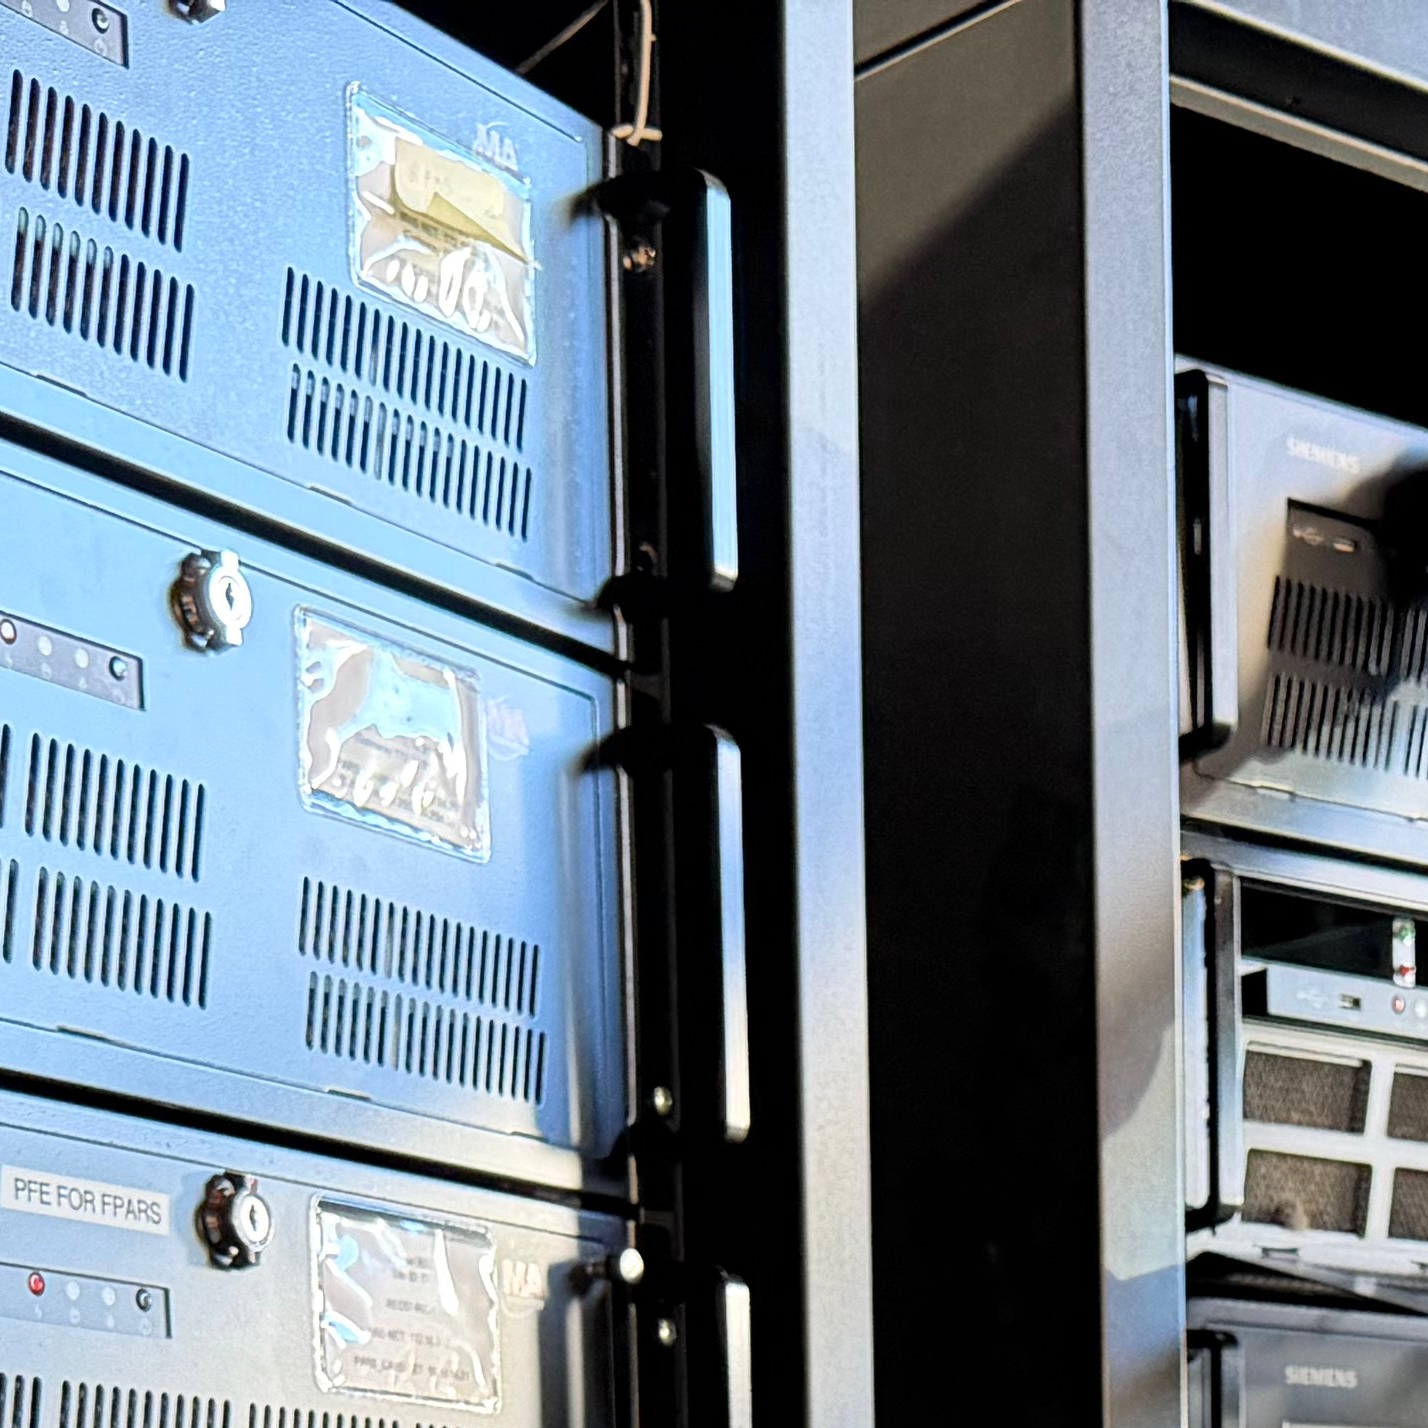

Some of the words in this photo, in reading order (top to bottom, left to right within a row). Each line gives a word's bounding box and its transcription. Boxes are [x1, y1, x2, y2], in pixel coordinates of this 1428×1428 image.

[13, 1177, 52, 1206] PFE
[56, 1185, 96, 1214] FOR
[101, 1193, 162, 1225] FPARS
[1284, 1365, 1358, 1389] SIEMENS
